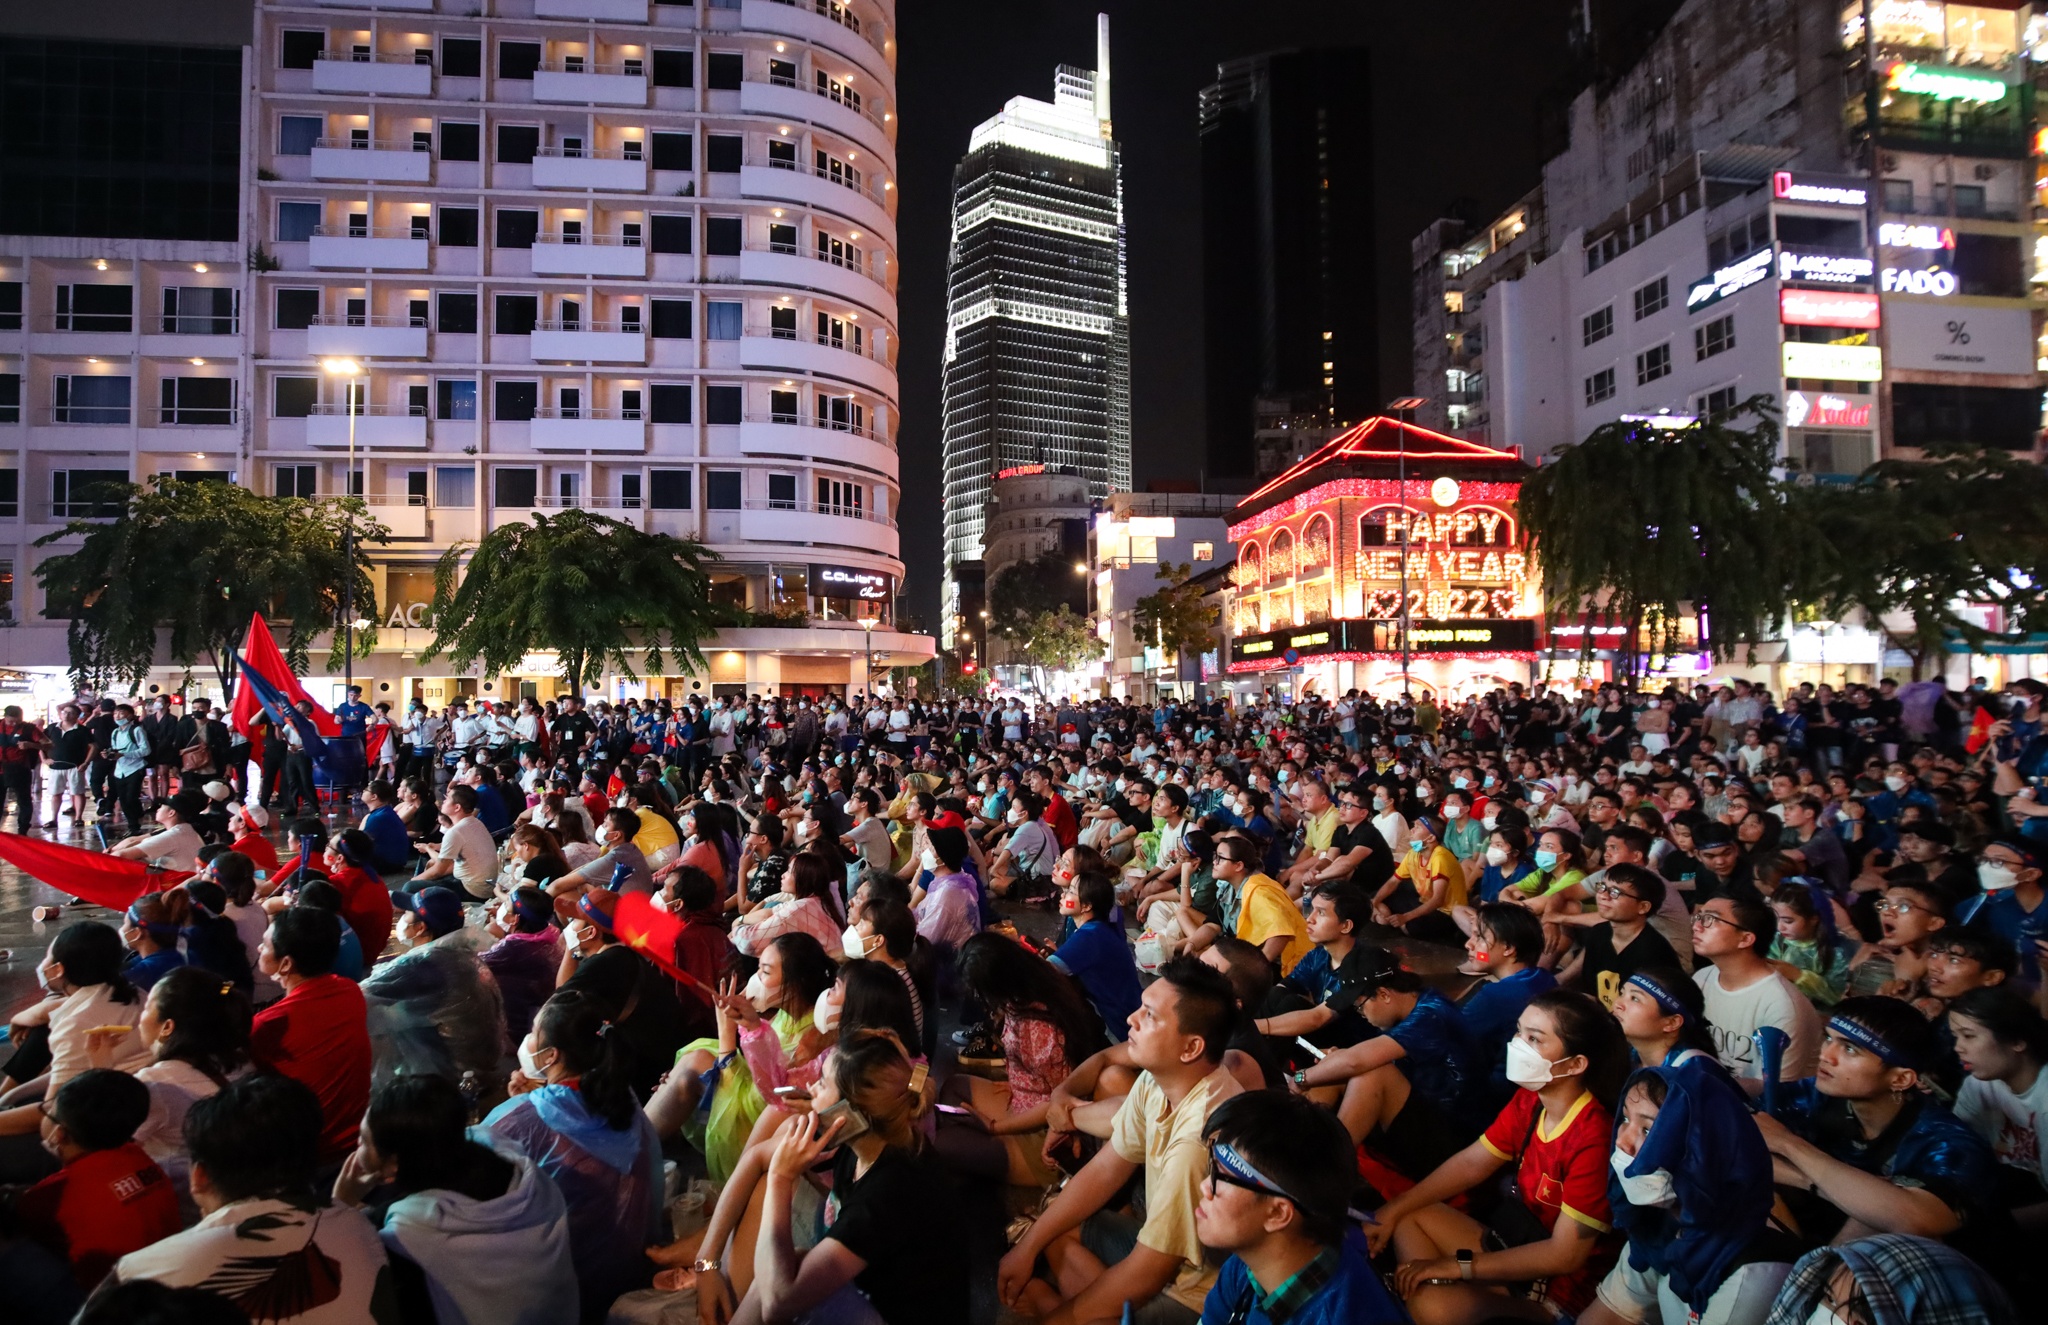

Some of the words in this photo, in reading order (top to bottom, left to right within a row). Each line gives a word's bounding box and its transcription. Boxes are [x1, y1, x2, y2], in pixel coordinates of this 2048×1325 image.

[1018, 464, 1044, 475] GROUP
[1385, 511, 1501, 544] HAPPY
[1354, 549, 1430, 581] NEW
[1434, 549, 1528, 583] YEAR
[1407, 588, 1490, 620] 2022
